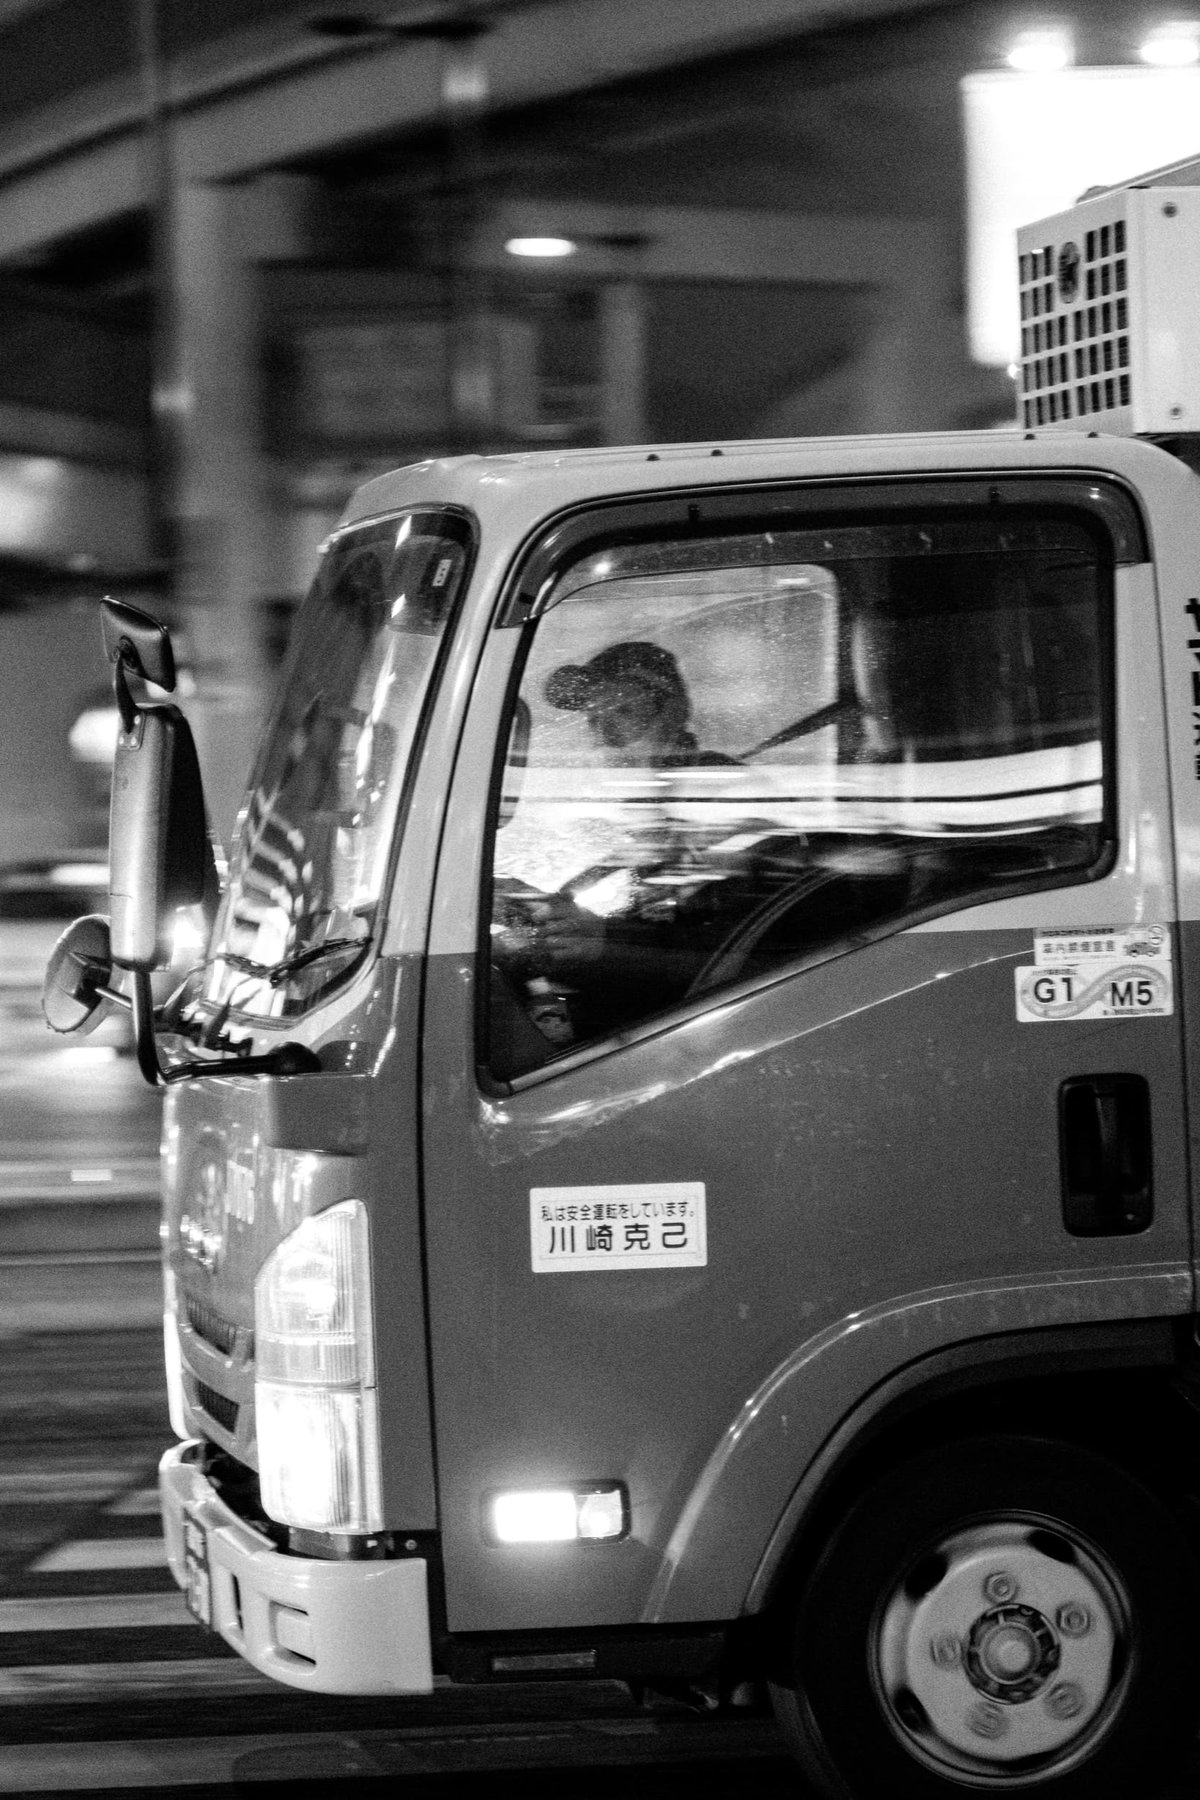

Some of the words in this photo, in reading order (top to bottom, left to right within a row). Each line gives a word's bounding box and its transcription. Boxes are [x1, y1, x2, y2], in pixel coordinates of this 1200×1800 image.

[1034, 977, 1072, 1003] G1
[1112, 981, 1152, 1006] M5
[541, 1202, 695, 1222] 私は安全運転をしています。
[549, 1222, 687, 1253] 川崎克己
